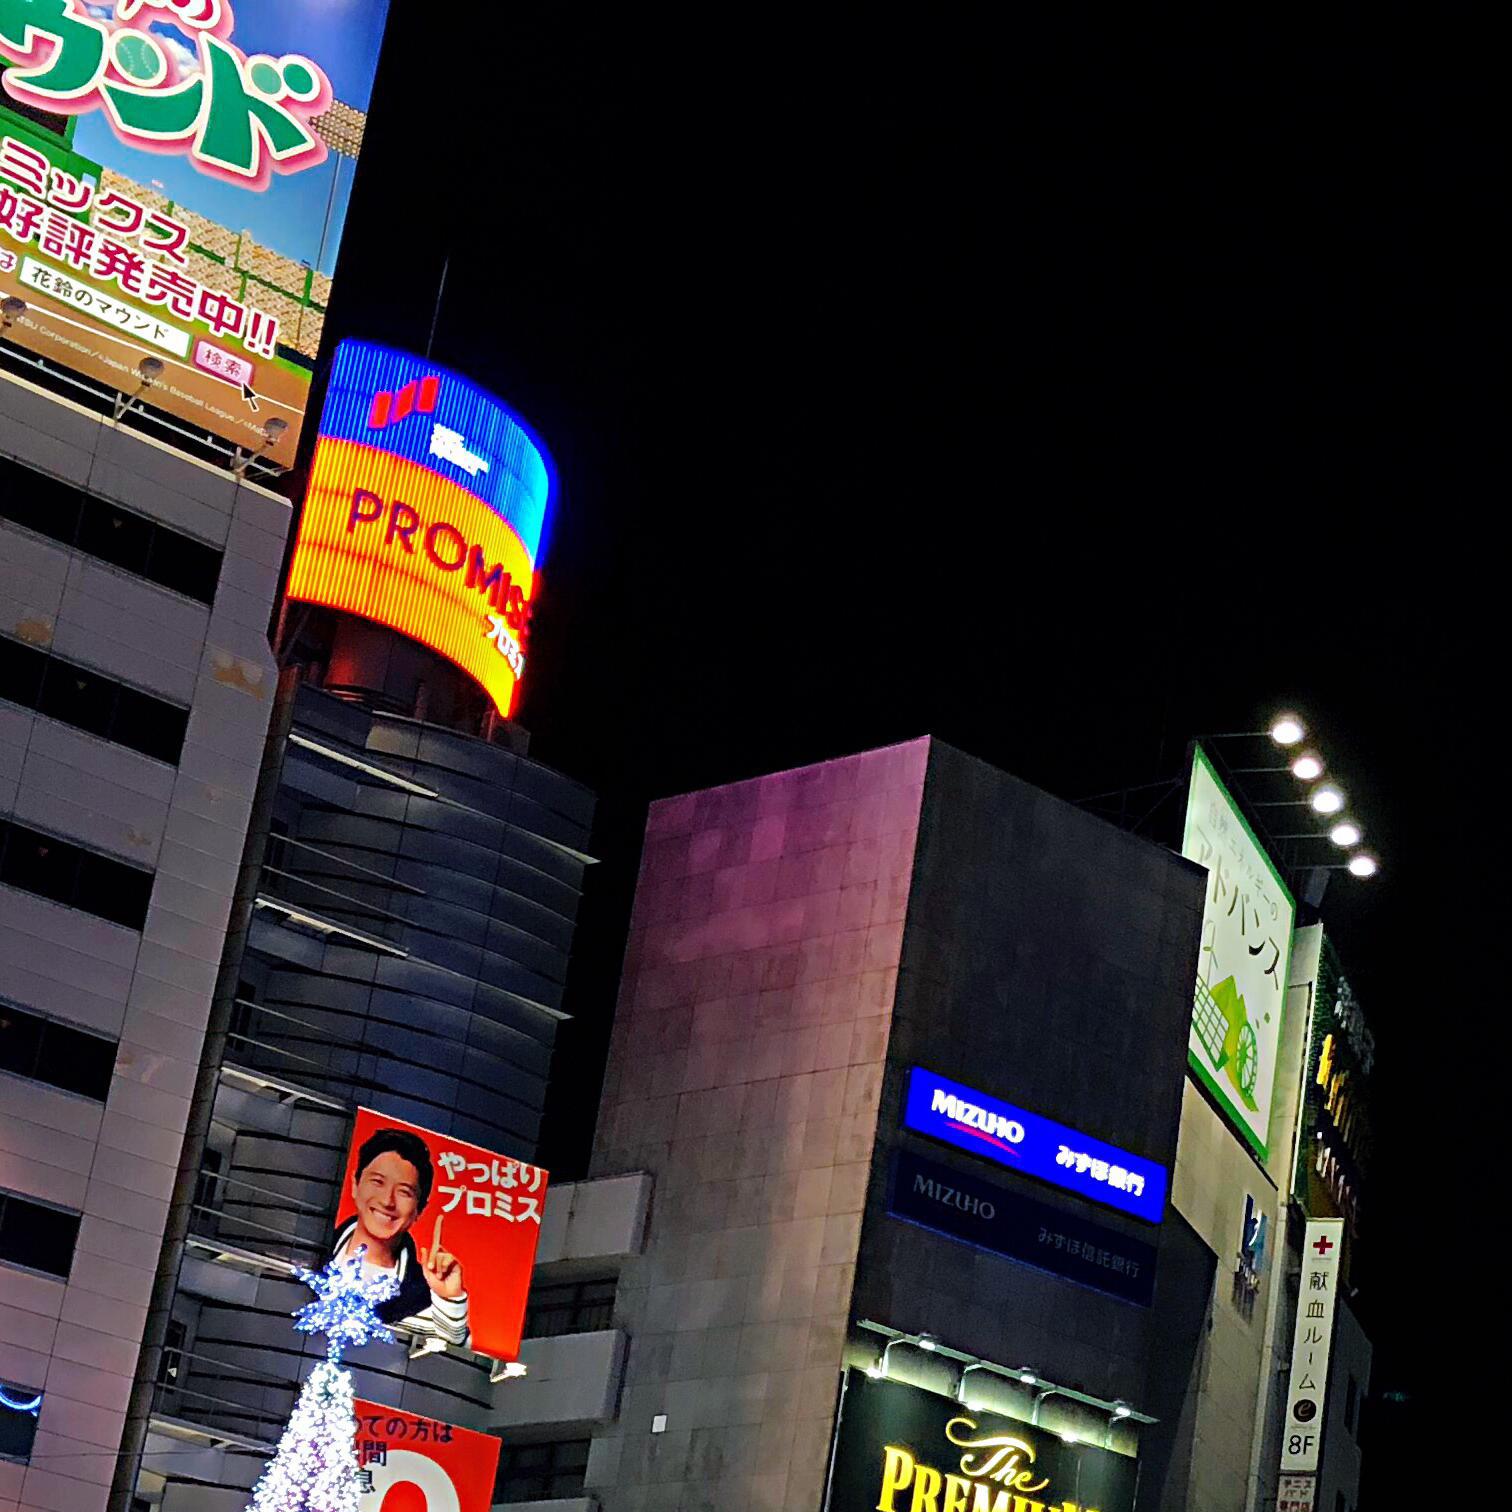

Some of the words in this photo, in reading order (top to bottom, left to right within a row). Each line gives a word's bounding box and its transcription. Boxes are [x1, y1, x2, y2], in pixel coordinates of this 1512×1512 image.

[31, 265, 169, 340] 花鈴のマウンド
[204, 348, 243, 381] 検索
[438, 1151, 541, 1192] やっぱり
[931, 1089, 1025, 1144] MIZUHO
[1055, 1145, 1146, 1197] みずほ銀行
[438, 1185, 541, 1225] プロミス
[913, 1174, 995, 1220] MIZUHO
[1038, 1227, 1141, 1279] みずほ信託銀行
[1299, 1271, 1329, 1391] 献血ルーム
[945, 1417, 1049, 1492] The
[1288, 1435, 1315, 1455] 8F
